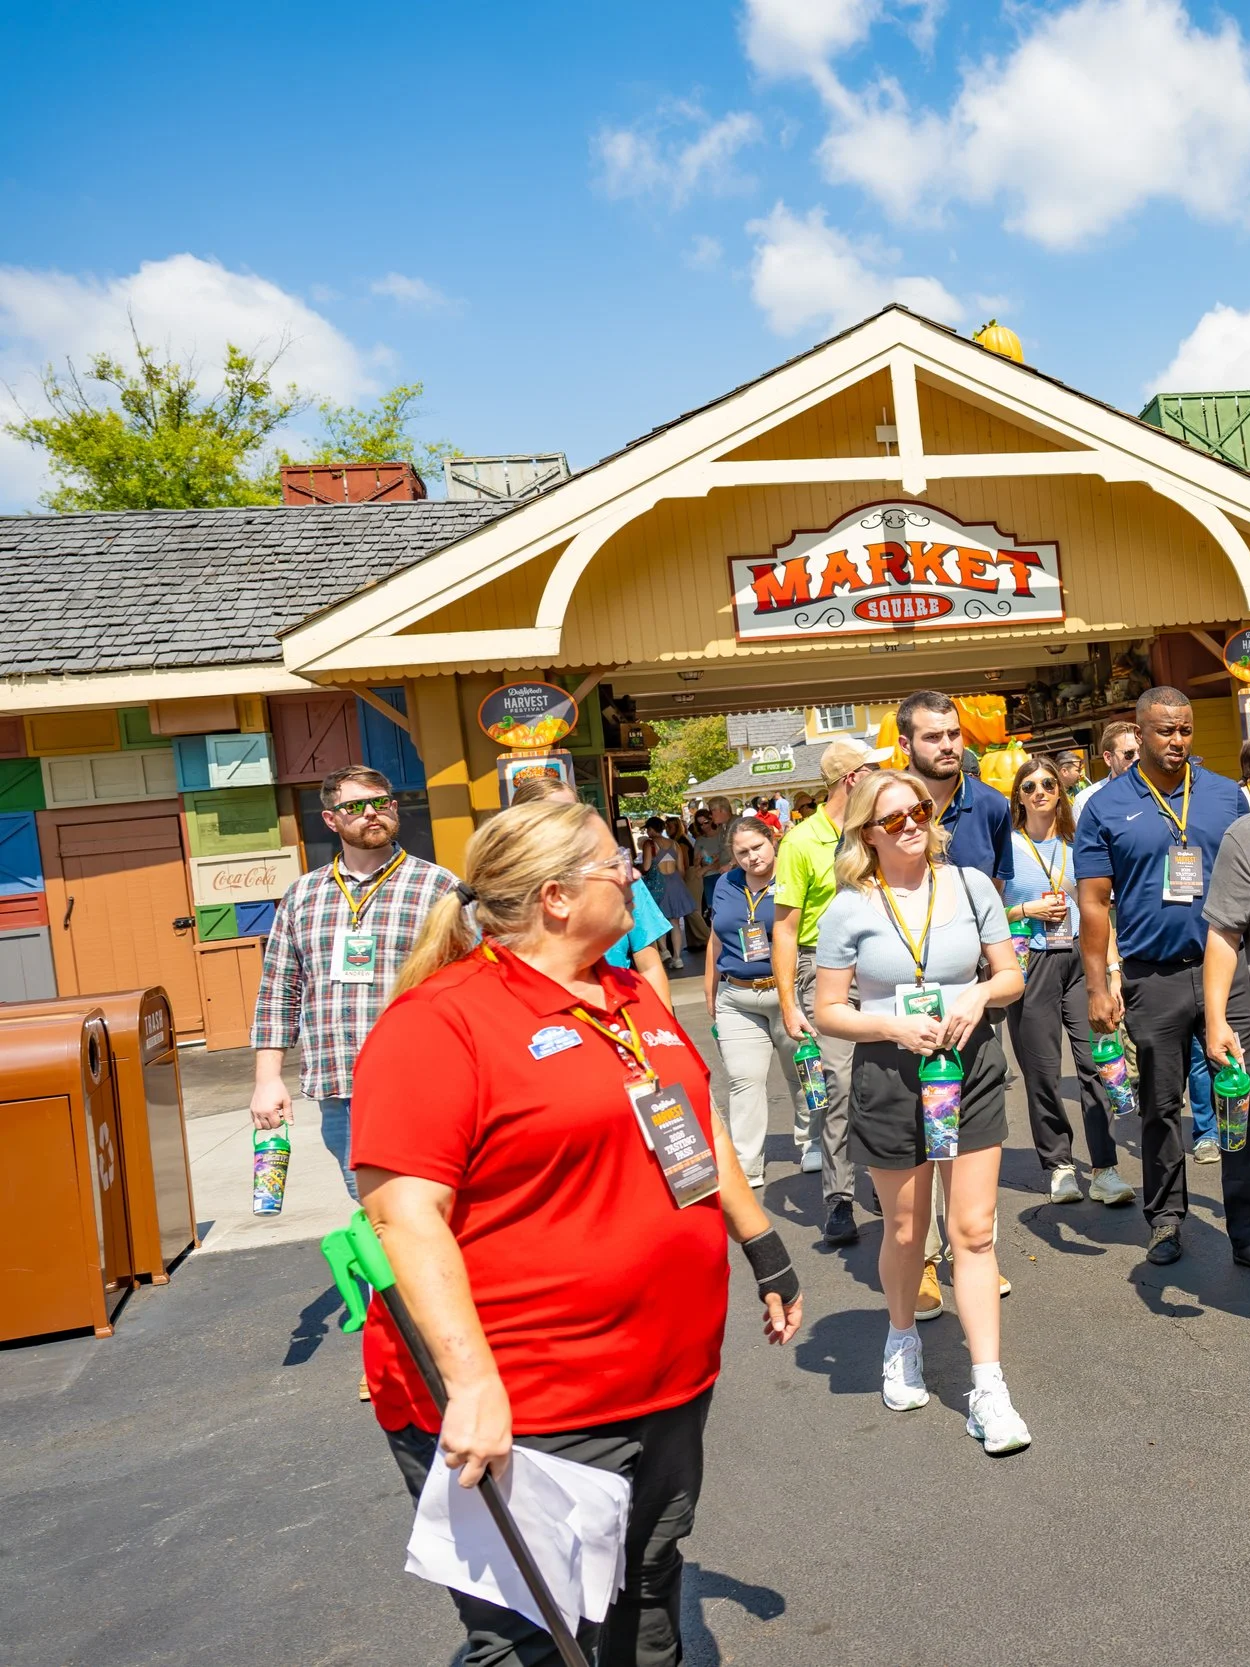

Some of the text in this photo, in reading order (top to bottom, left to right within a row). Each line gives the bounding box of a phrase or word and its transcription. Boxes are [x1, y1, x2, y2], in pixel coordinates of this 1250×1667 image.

[747, 540, 1045, 615] MARKET
[867, 597, 940, 618] SQUARE
[503, 695, 549, 709] HARVEST
[144, 1009, 163, 1036] TRASH
[651, 1104, 684, 1127] HARVEST
[664, 1135, 697, 1155] TASTING
[675, 1146, 694, 1161] PASS
